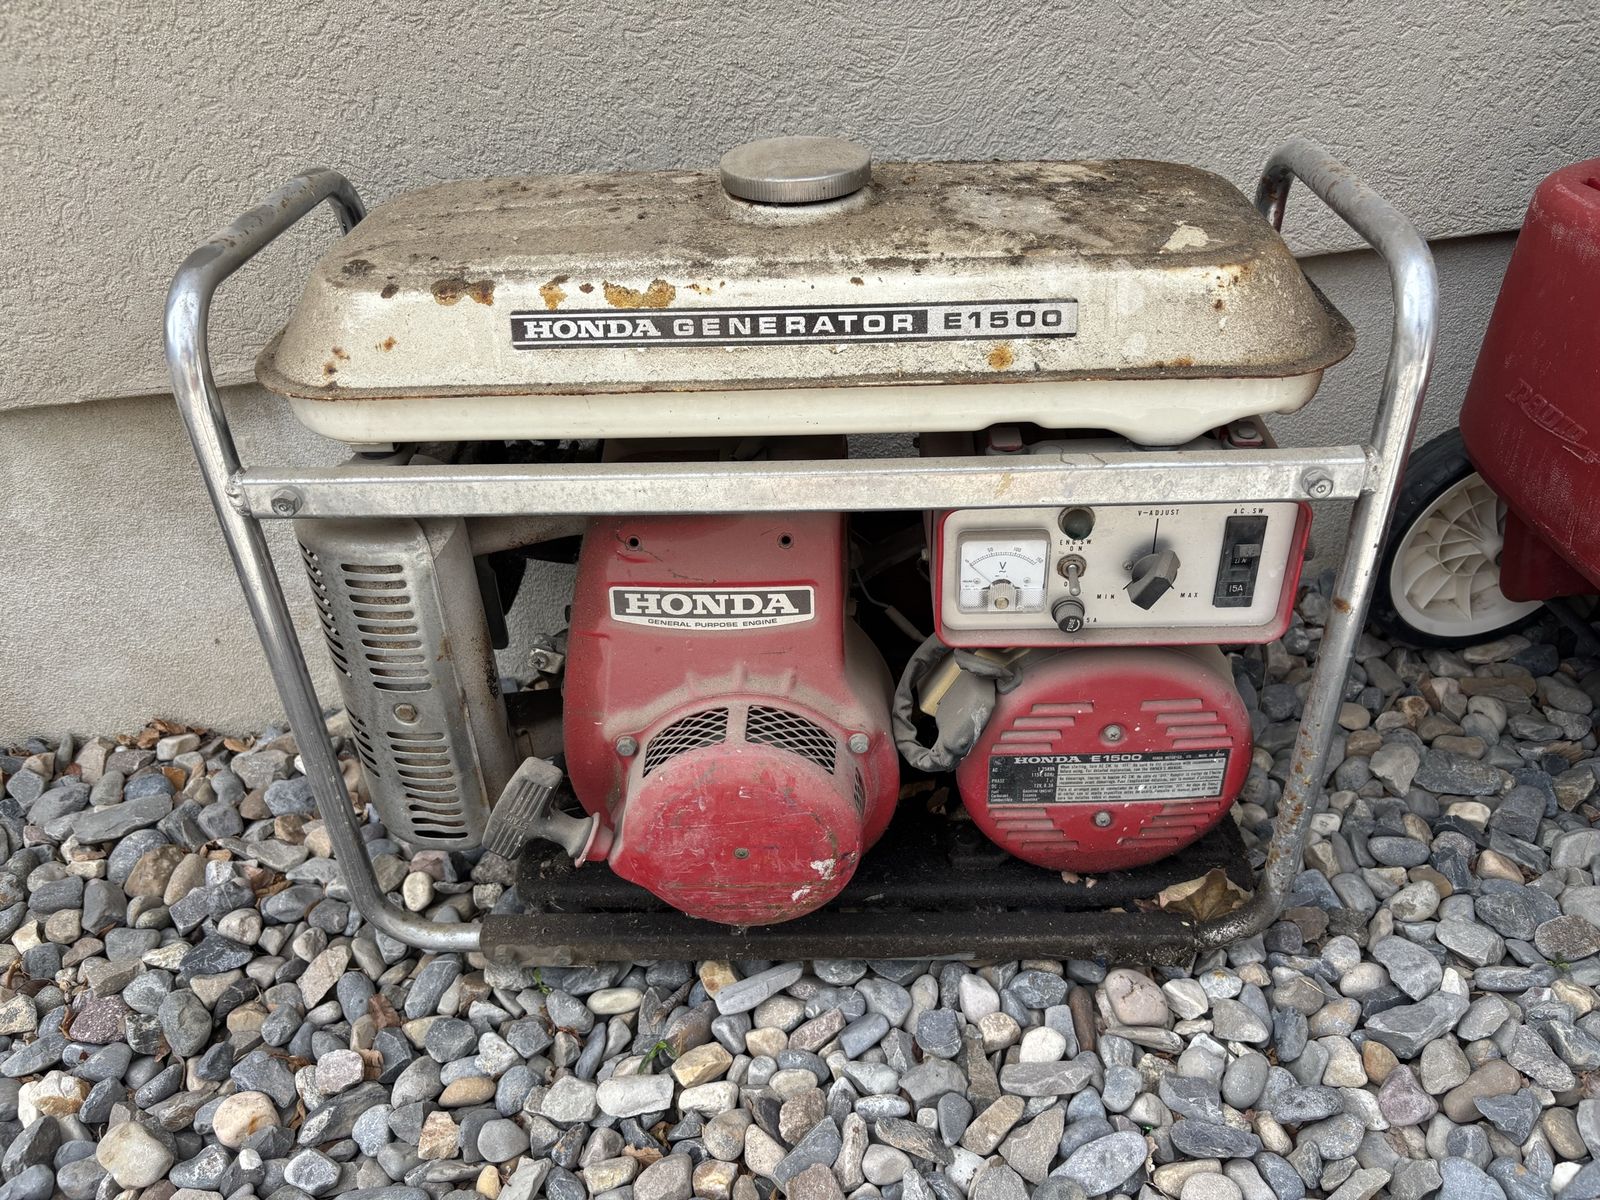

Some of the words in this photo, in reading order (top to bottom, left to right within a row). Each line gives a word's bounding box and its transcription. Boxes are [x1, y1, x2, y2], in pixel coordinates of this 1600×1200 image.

[523, 319, 662, 339] HONDA
[673, 309, 914, 337] GENERATOR
[943, 309, 1062, 330] E1500
[1137, 509, 1181, 517] V-ADJUST
[999, 561, 1007, 570] V
[1228, 584, 1244, 593] 15A
[624, 593, 799, 616] HONDA
[647, 618, 692, 628] GENERAL
[742, 617, 778, 627] ENGINE
[1013, 755, 1081, 765] HONDA
[1091, 754, 1142, 763] E1500
